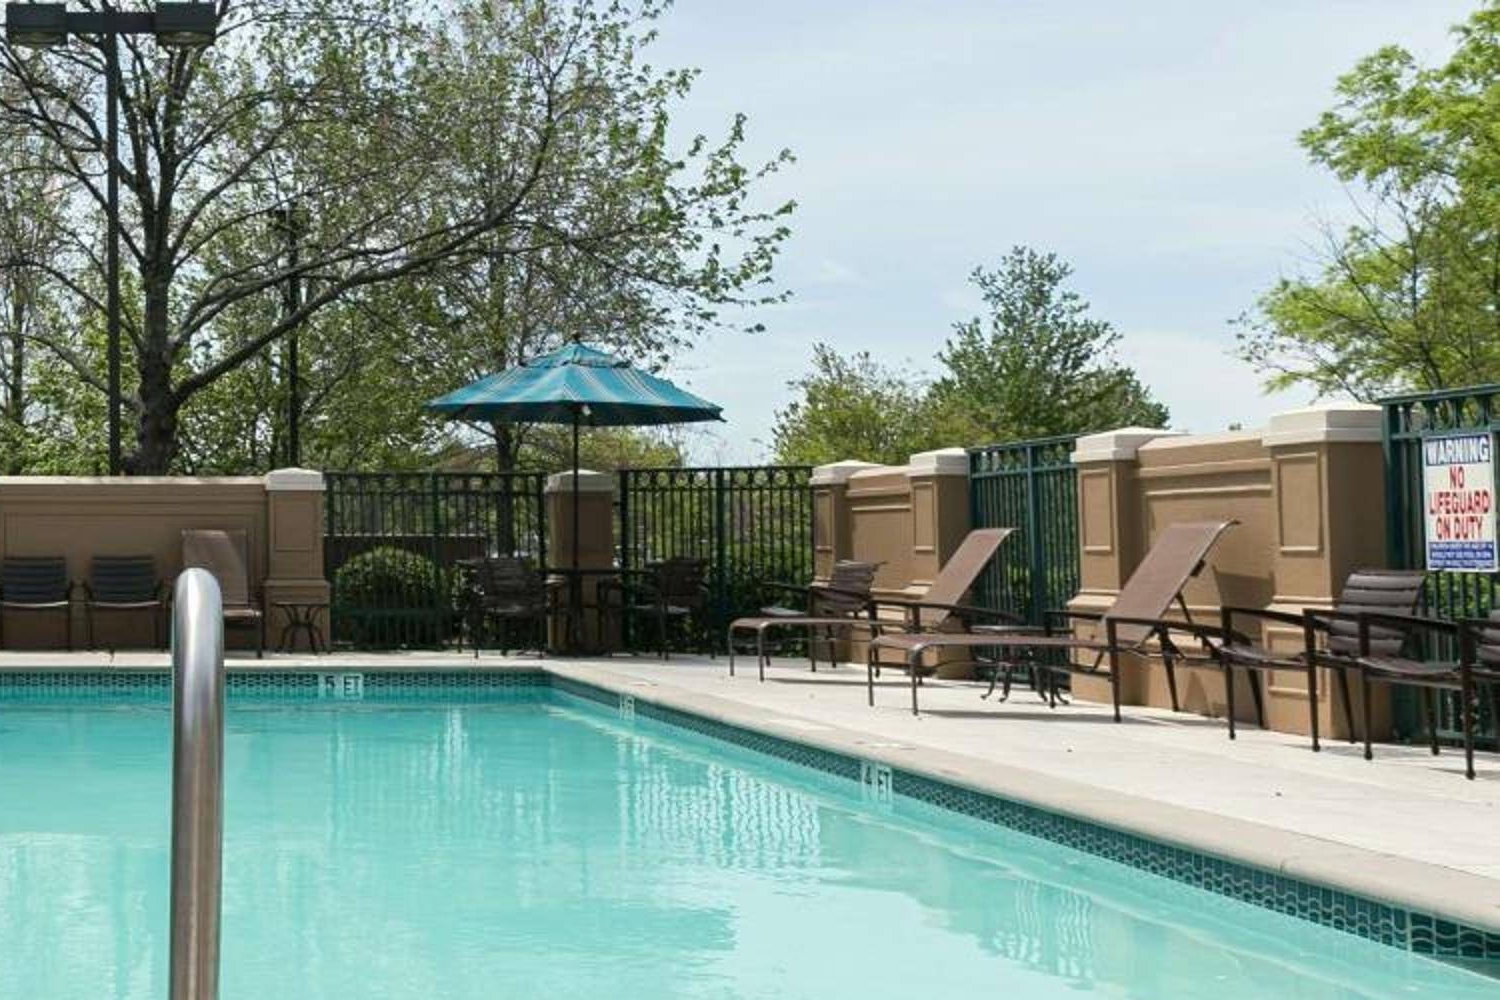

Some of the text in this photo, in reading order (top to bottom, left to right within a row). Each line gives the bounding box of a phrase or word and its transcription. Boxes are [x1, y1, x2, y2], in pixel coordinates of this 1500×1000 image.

[1427, 436, 1490, 464] WARNING
[1449, 466, 1464, 488] NO
[1429, 490, 1490, 514] LIFEGUARD
[1436, 516, 1482, 540] ON DUTY
